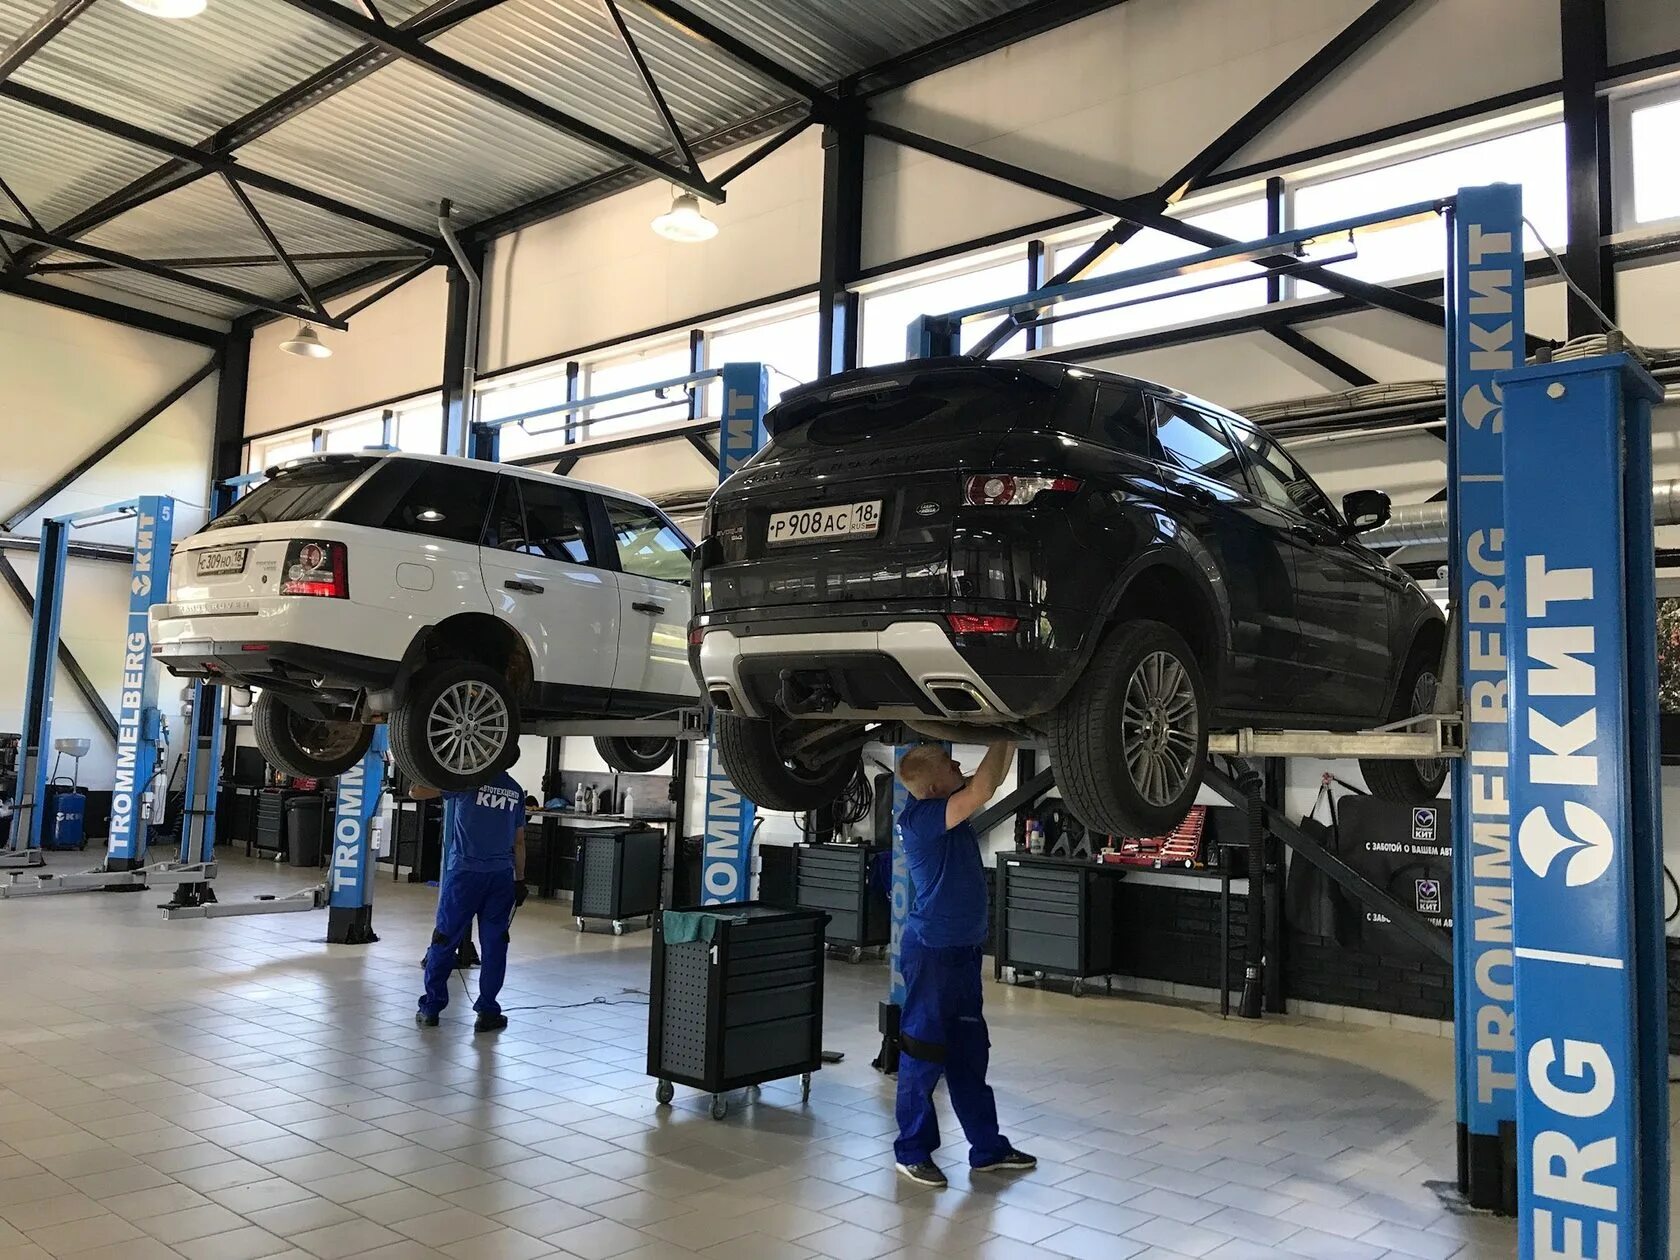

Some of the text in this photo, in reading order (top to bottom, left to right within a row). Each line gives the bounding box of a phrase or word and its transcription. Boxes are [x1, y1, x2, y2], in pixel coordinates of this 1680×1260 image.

[1468, 223, 1513, 371] КИТ
[162, 505, 170, 521] 5
[774, 504, 873, 538] Р908АС 18
[851, 522, 866, 531] RUS
[135, 512, 154, 572] КИТ
[1525, 554, 1599, 786] КИТ
[109, 632, 146, 853] TROMMELBERG
[475, 791, 519, 812] КИТ
[1415, 830, 1433, 839] КИТ
[1365, 842, 1371, 851] С
[1372, 841, 1402, 853] ЗАБОТОЙ
[1403, 844, 1410, 853] О
[1411, 845, 1439, 856] ВАШЕМ
[1366, 912, 1371, 921] С
[1419, 903, 1438, 911] КИТ
[710, 945, 718, 965] 1
